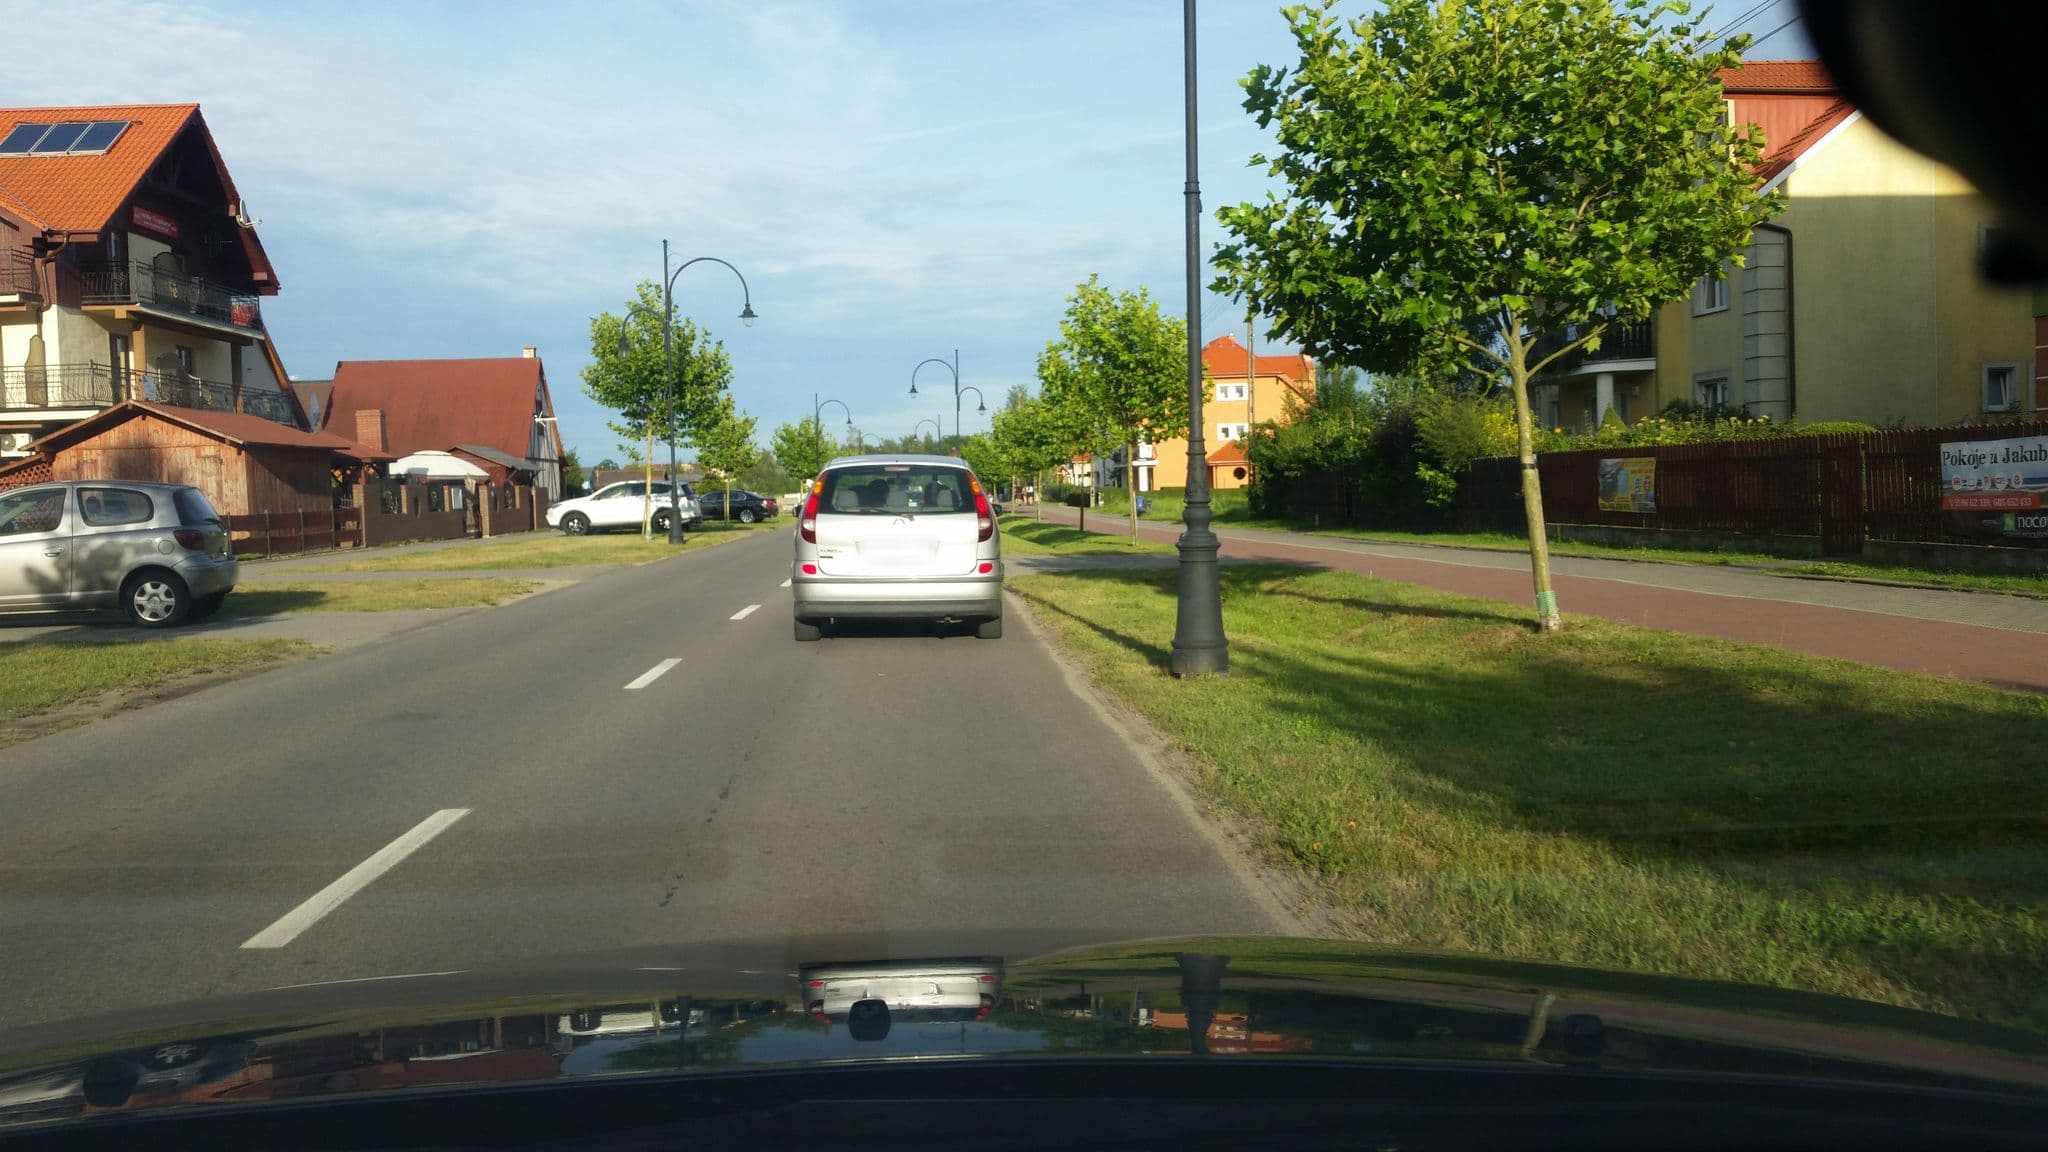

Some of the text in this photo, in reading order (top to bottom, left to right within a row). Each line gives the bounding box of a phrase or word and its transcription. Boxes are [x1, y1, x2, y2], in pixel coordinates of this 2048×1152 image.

[1943, 443, 2048, 470] Pokoje u Jakub
[2017, 516, 2048, 528] noco
